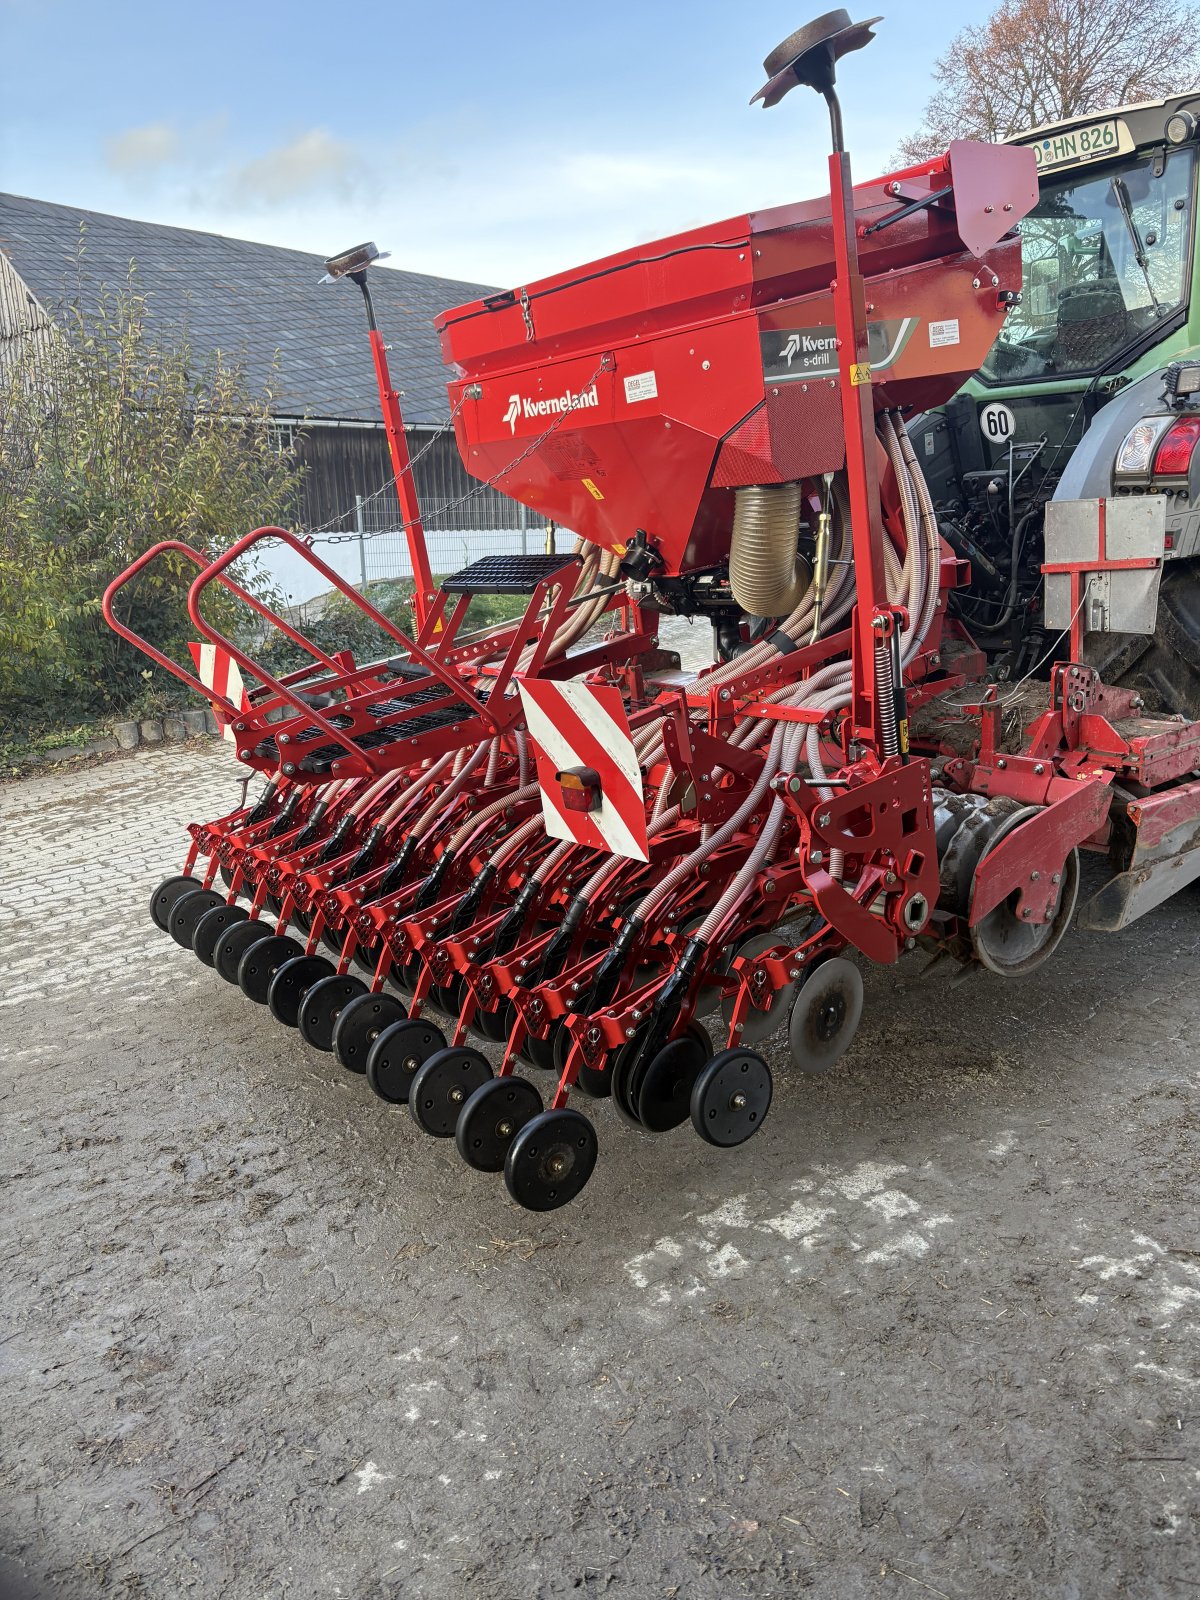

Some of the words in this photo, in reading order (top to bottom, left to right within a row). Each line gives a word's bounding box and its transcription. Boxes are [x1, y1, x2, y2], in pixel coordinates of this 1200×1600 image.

[1053, 135, 1076, 159] HN
[1080, 125, 1113, 151] 826
[802, 335, 837, 352] Kvern
[803, 352, 830, 367] s-drill
[522, 384, 599, 418] Kverneland
[986, 410, 1009, 437] 60
